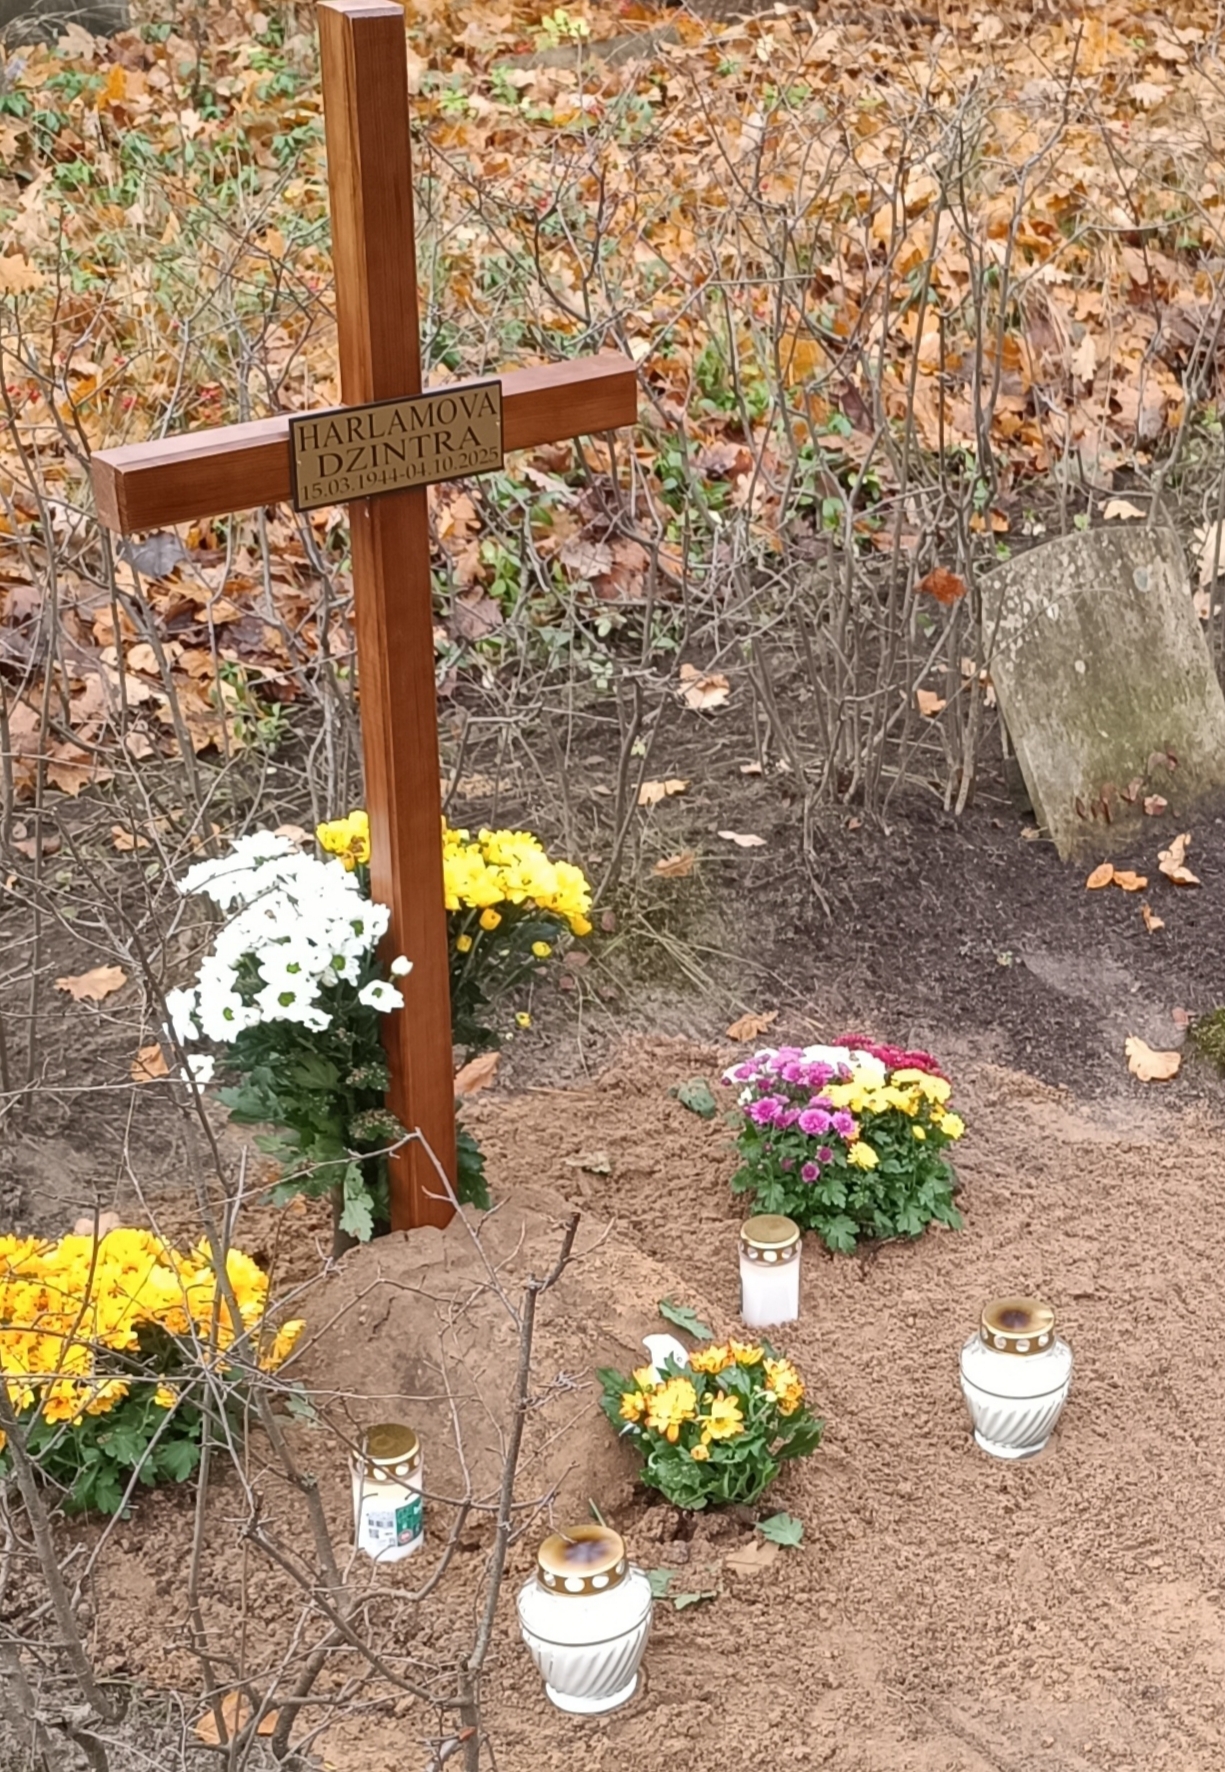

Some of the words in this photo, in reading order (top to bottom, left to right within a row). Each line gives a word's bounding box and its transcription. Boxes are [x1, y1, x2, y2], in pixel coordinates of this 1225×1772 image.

[298, 390, 498, 452] HARLAMOVA
[301, 446, 500, 501] 15.03.1944-04.10.2025
[318, 425, 482, 478] DZINTRA
